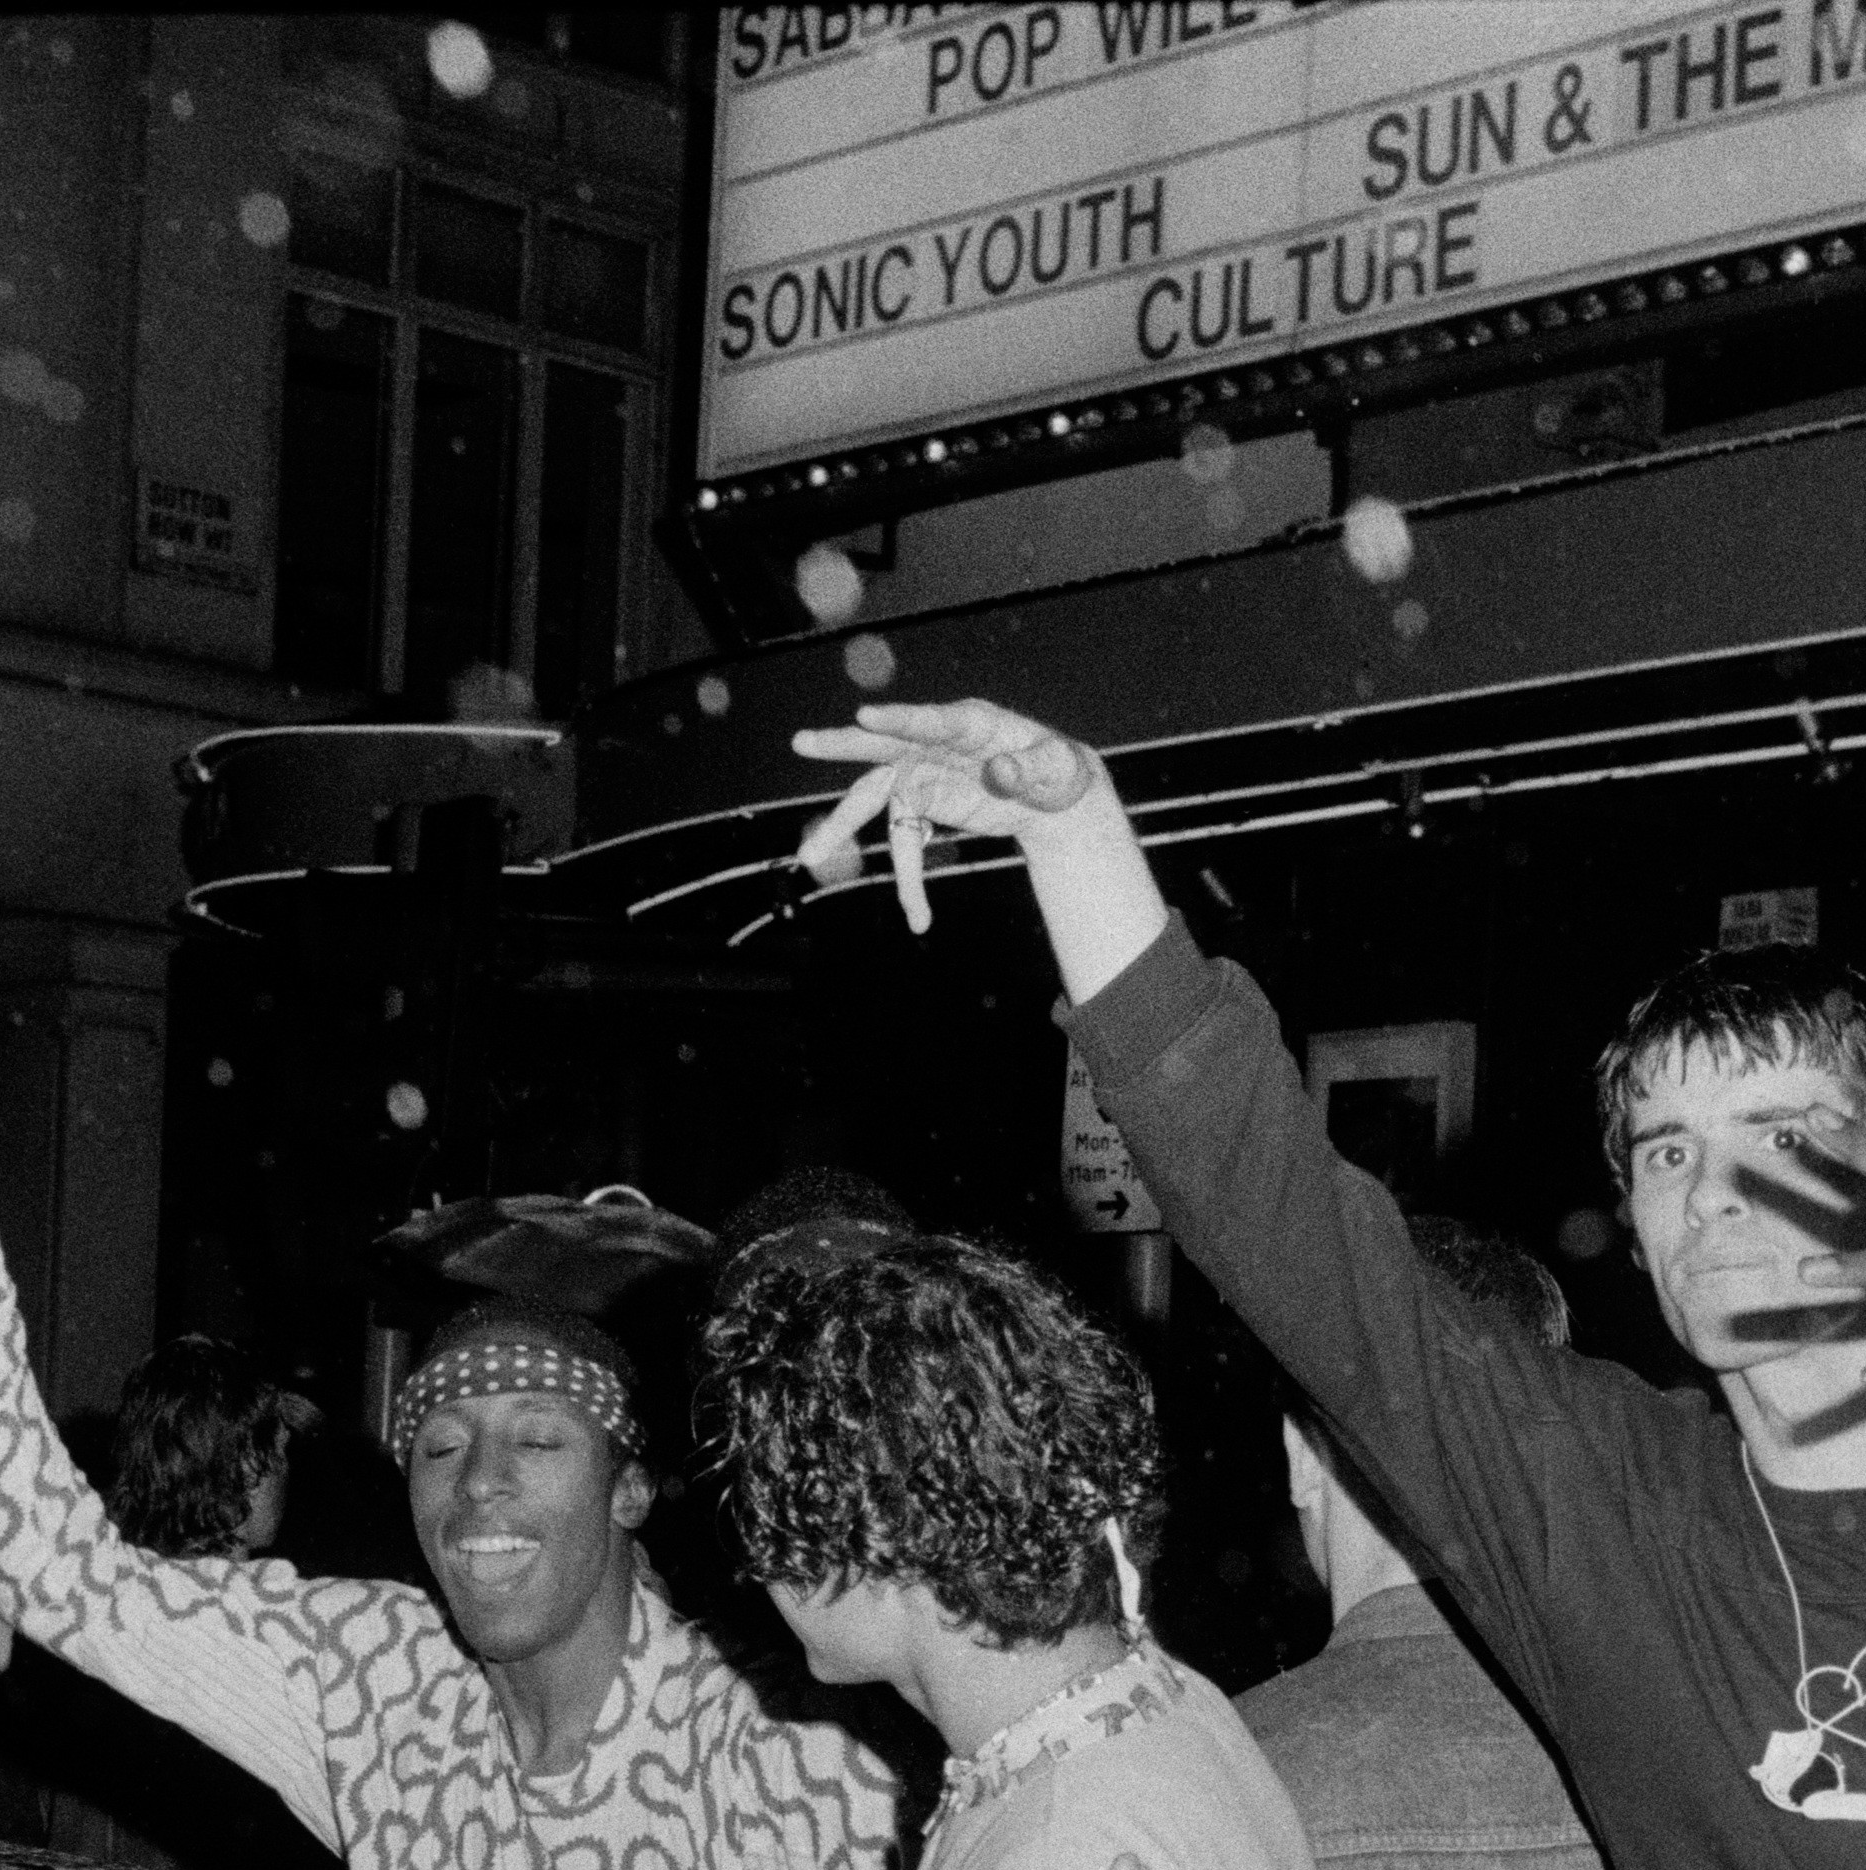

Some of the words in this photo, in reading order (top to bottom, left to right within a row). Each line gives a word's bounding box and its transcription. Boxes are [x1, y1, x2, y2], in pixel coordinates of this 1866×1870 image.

[928, 8, 1061, 114] POP
[1363, 80, 1519, 202] SUN
[1541, 62, 1593, 154] &
[1621, 8, 1784, 131] THE
[719, 244, 914, 360] SONIC
[934, 175, 1165, 306] YOUTH
[1136, 201, 1479, 360] CULTURE
